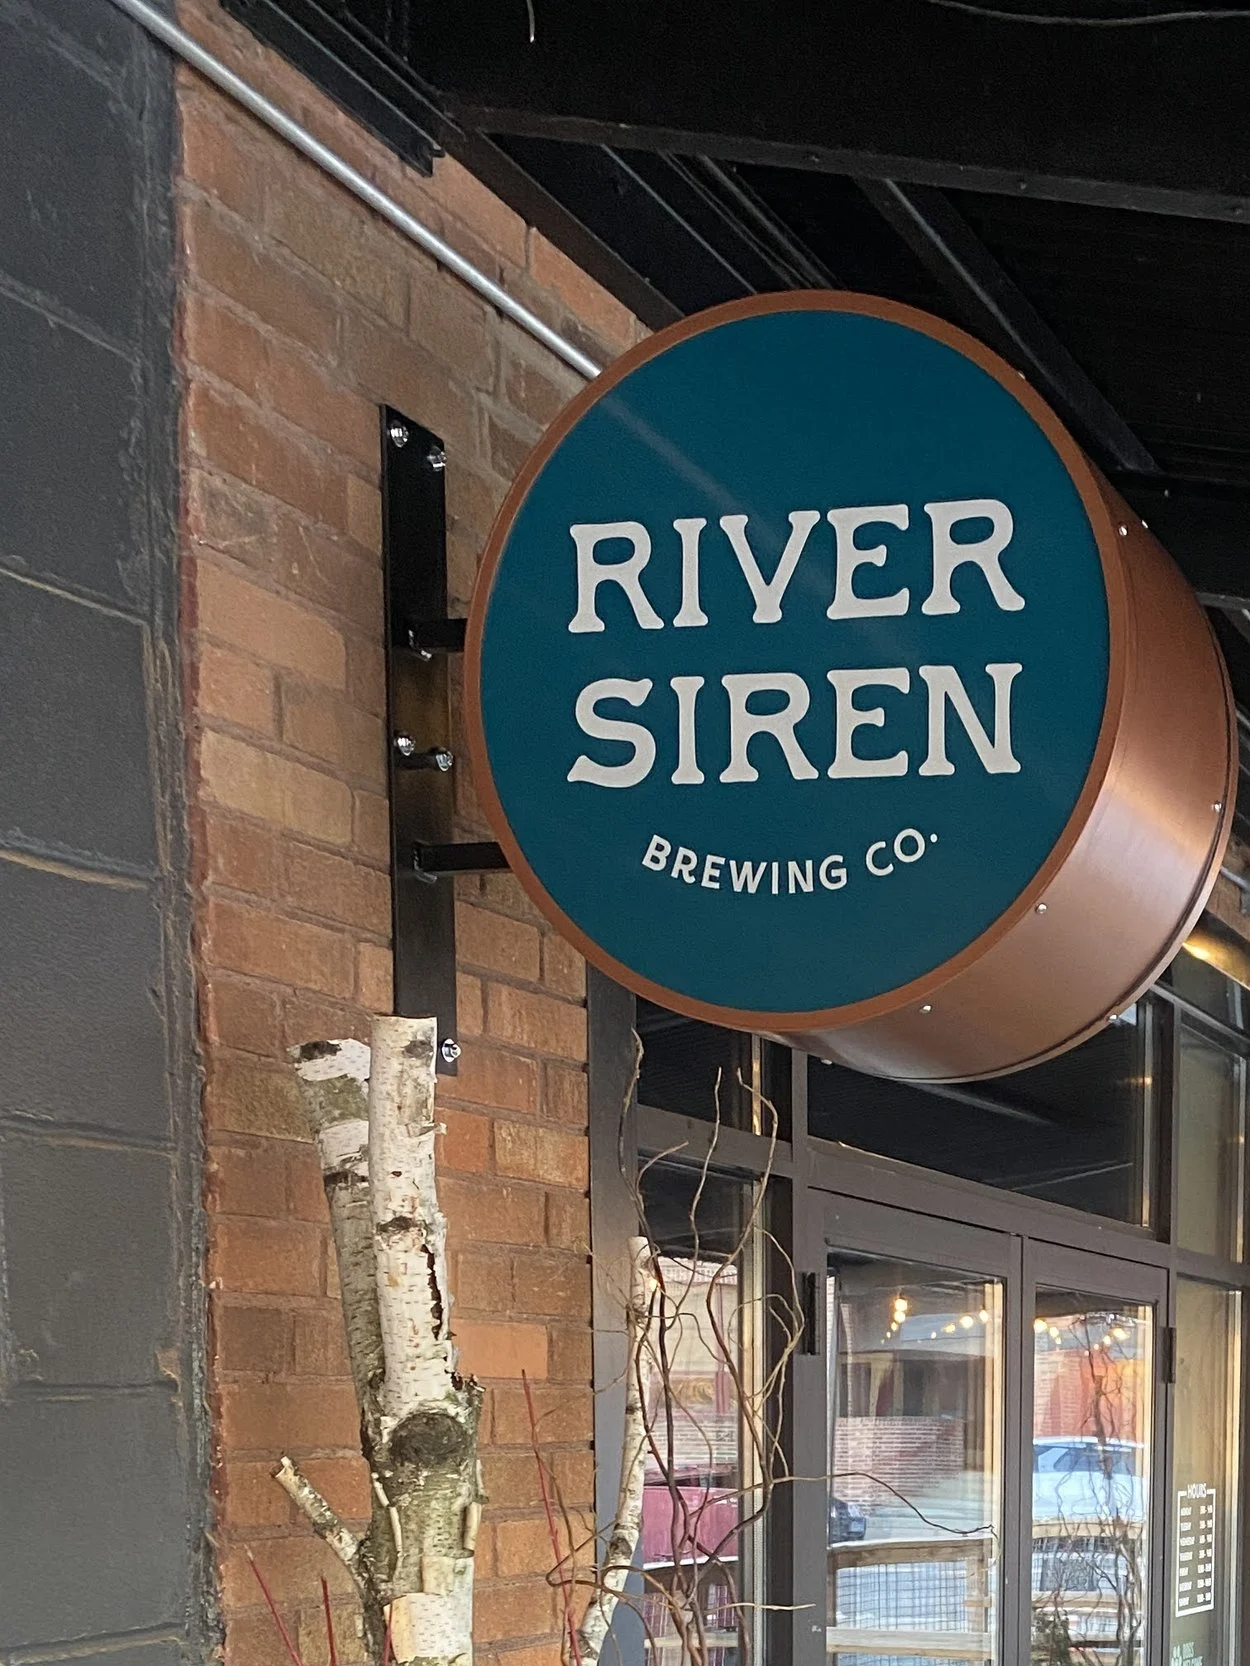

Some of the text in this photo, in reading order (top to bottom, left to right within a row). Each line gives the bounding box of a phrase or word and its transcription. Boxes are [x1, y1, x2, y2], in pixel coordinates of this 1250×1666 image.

[568, 498, 1026, 633] RIVER
[567, 662, 1024, 788] SIREN
[641, 834, 849, 895] BREWING
[1187, 1483, 1207, 1499] HOURS
